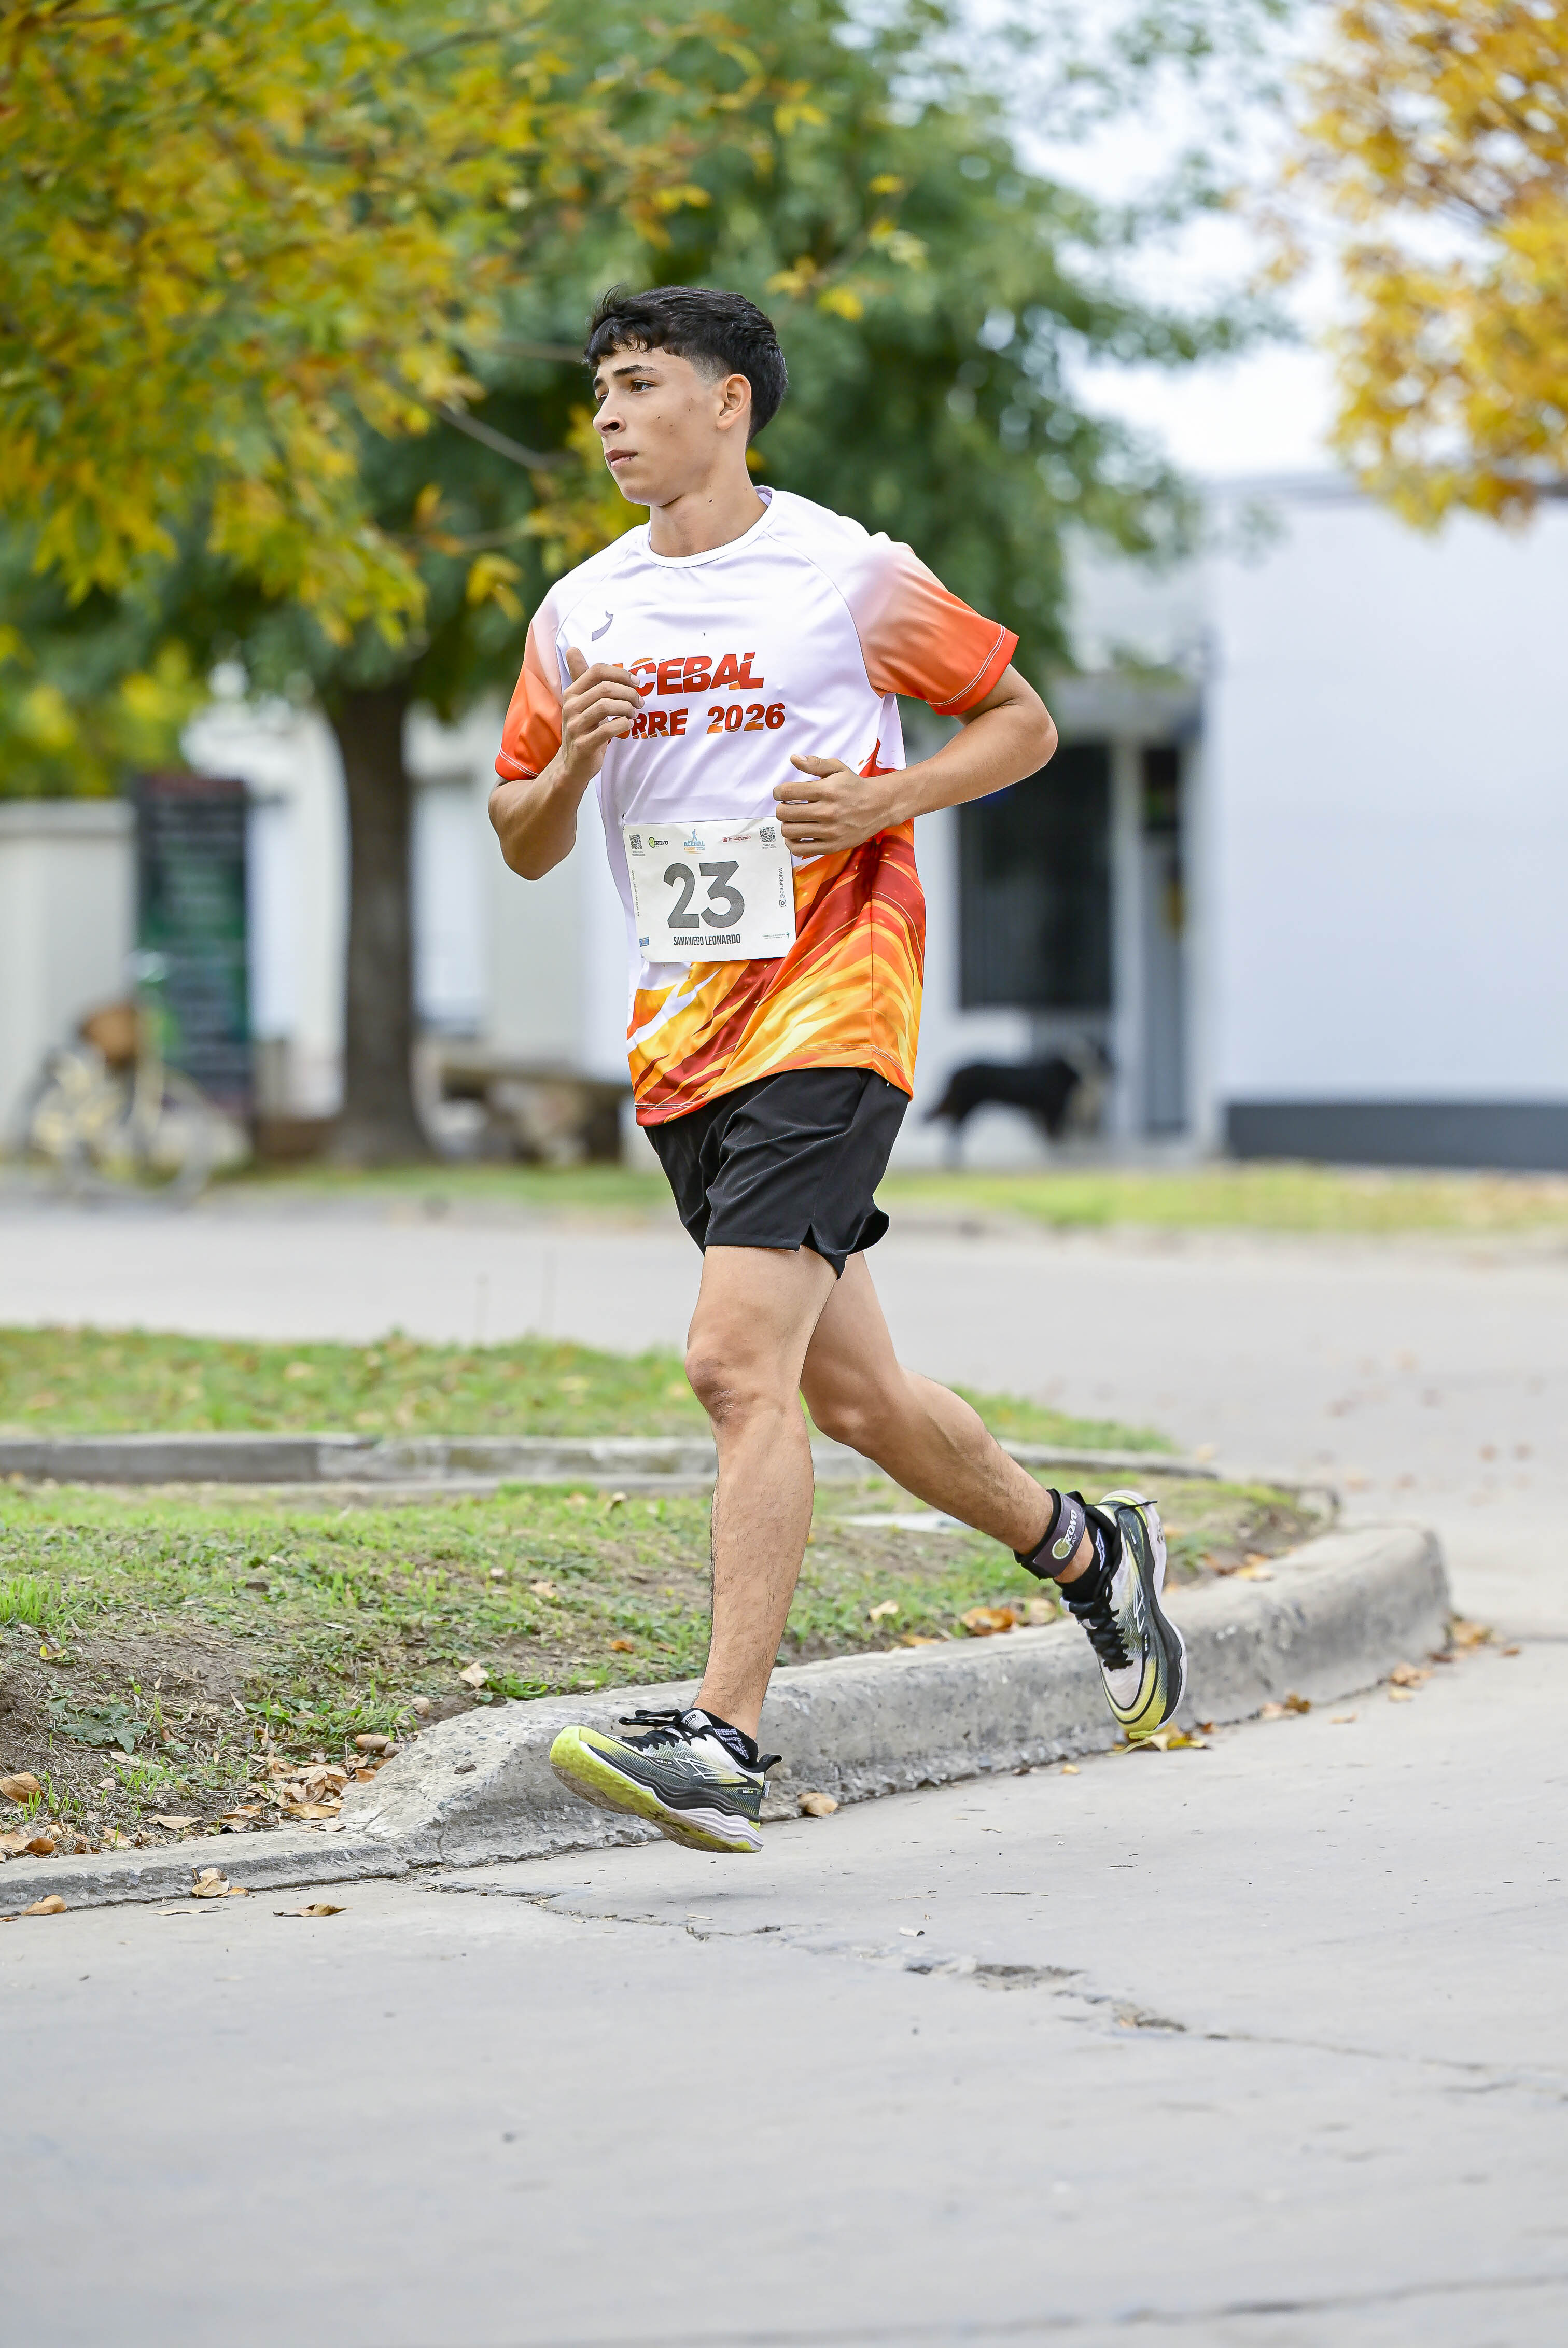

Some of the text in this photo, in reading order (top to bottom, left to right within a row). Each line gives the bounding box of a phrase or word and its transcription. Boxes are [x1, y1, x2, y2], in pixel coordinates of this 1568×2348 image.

[611, 652, 764, 697] CEBAL
[607, 703, 786, 745] RRE 2026
[663, 861, 745, 928] 23
[674, 934, 741, 946] SAMANIEGO LEONARDO
